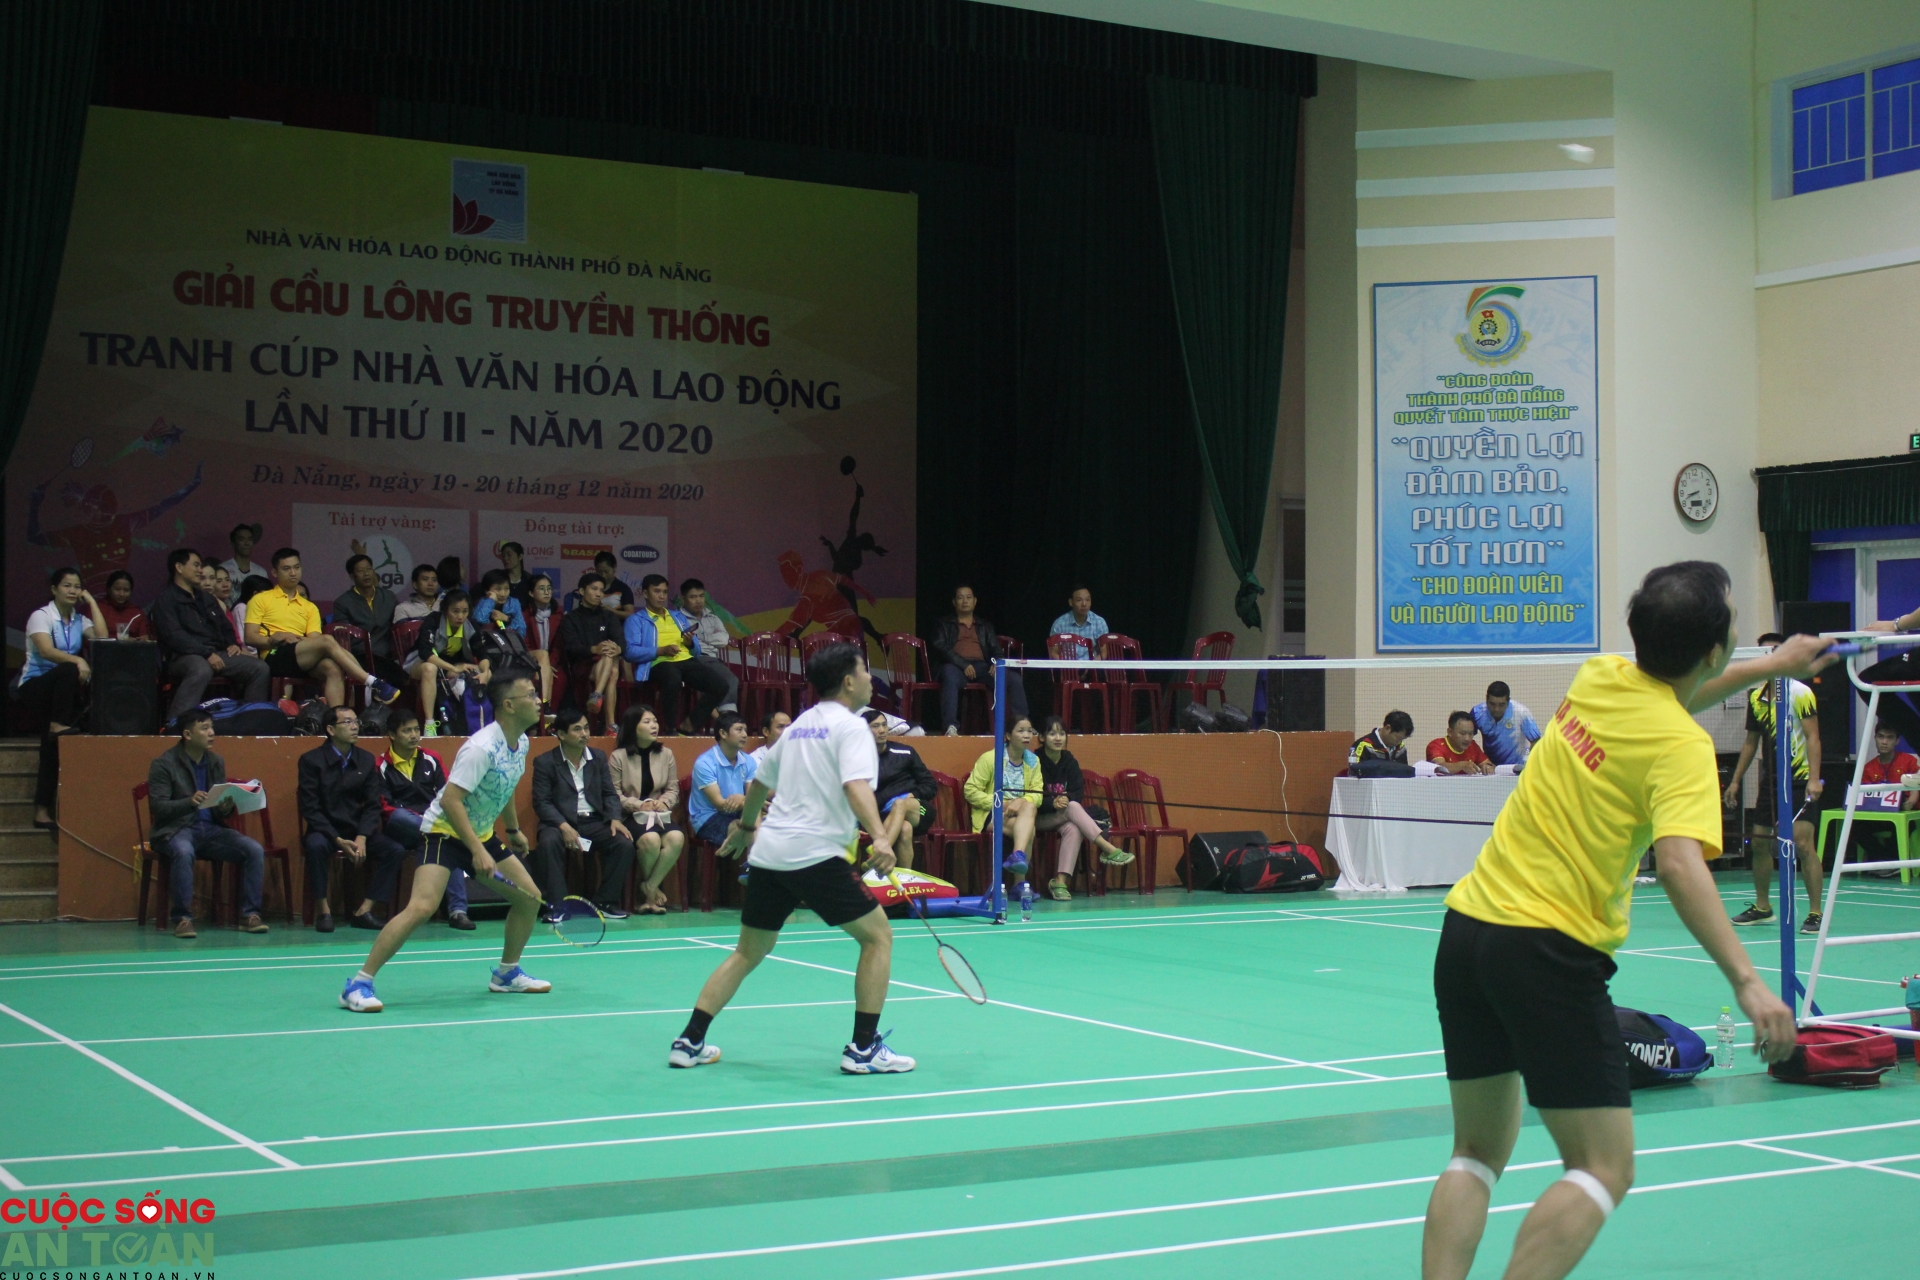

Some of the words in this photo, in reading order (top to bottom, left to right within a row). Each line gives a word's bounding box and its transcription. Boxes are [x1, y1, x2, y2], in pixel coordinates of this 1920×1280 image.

[246, 227, 292, 248] NHÀ
[297, 231, 341, 252] VĂN
[348, 236, 393, 256] HÓA
[399, 242, 438, 260] LAO
[444, 244, 502, 266] ĐỘNG
[508, 250, 574, 272] THÀNH
[581, 255, 621, 275] PHỐ
[627, 259, 653, 279] ĐÀ
[659, 261, 712, 283] NẴNG
[173, 262, 255, 309] GIẢI
[270, 268, 349, 316] CẦU
[363, 279, 472, 325] LÔNG
[486, 291, 634, 338] TRUYỀN
[647, 301, 770, 347] THỐNG
[79, 331, 232, 373] TRANH
[249, 335, 339, 379] CÚP
[353, 344, 444, 387] NHÀ
[455, 352, 539, 392] VĂN
[554, 356, 639, 398] HÓA
[652, 369, 724, 403] LAO
[737, 369, 841, 415] ĐỘNG
[1489, 371, 1533, 387] ĐOÀN
[1406, 391, 1459, 407] THÀNH
[1461, 387, 1496, 405] PHỐ
[1495, 388, 1518, 404] ĐÀ
[245, 387, 329, 436] LẦN
[342, 400, 430, 441] THỨ
[443, 410, 466, 443] II
[509, 410, 603, 450] NĂM
[617, 420, 713, 455] 2020
[1394, 407, 1445, 425] QUYẾT
[1448, 407, 1485, 423] TÂM
[1487, 406, 1529, 422] THỰC
[1527, 430, 1582, 459] LỢI
[251, 464, 285, 485] Đà
[292, 463, 361, 491] Nẵng,
[368, 472, 425, 494] ngày
[430, 473, 456, 492] 19
[475, 475, 501, 493] 20
[506, 477, 569, 499] tháng
[575, 478, 601, 497] 12
[607, 481, 652, 499] năm
[658, 482, 705, 500] 2020
[1405, 465, 1484, 495] ĐẢM
[1691, 468, 1698, 476] 12
[328, 511, 356, 526] Tài
[361, 515, 387, 531] trợ
[391, 515, 436, 531] vàng:
[524, 517, 567, 535] Đồng
[571, 521, 592, 534] tài
[597, 524, 625, 538] trợ:
[1412, 502, 1499, 531] PHÚC
[1507, 502, 1563, 531] LỢI
[1410, 535, 1472, 566] TỐT
[1463, 571, 1514, 595] ĐOÀN
[1518, 571, 1563, 594] VIÊN
[1390, 602, 1415, 625] VÀ
[1420, 602, 1476, 624] NGƯỜI
[1480, 604, 1518, 624] LAO
[1884, 790, 1898, 806] 4
